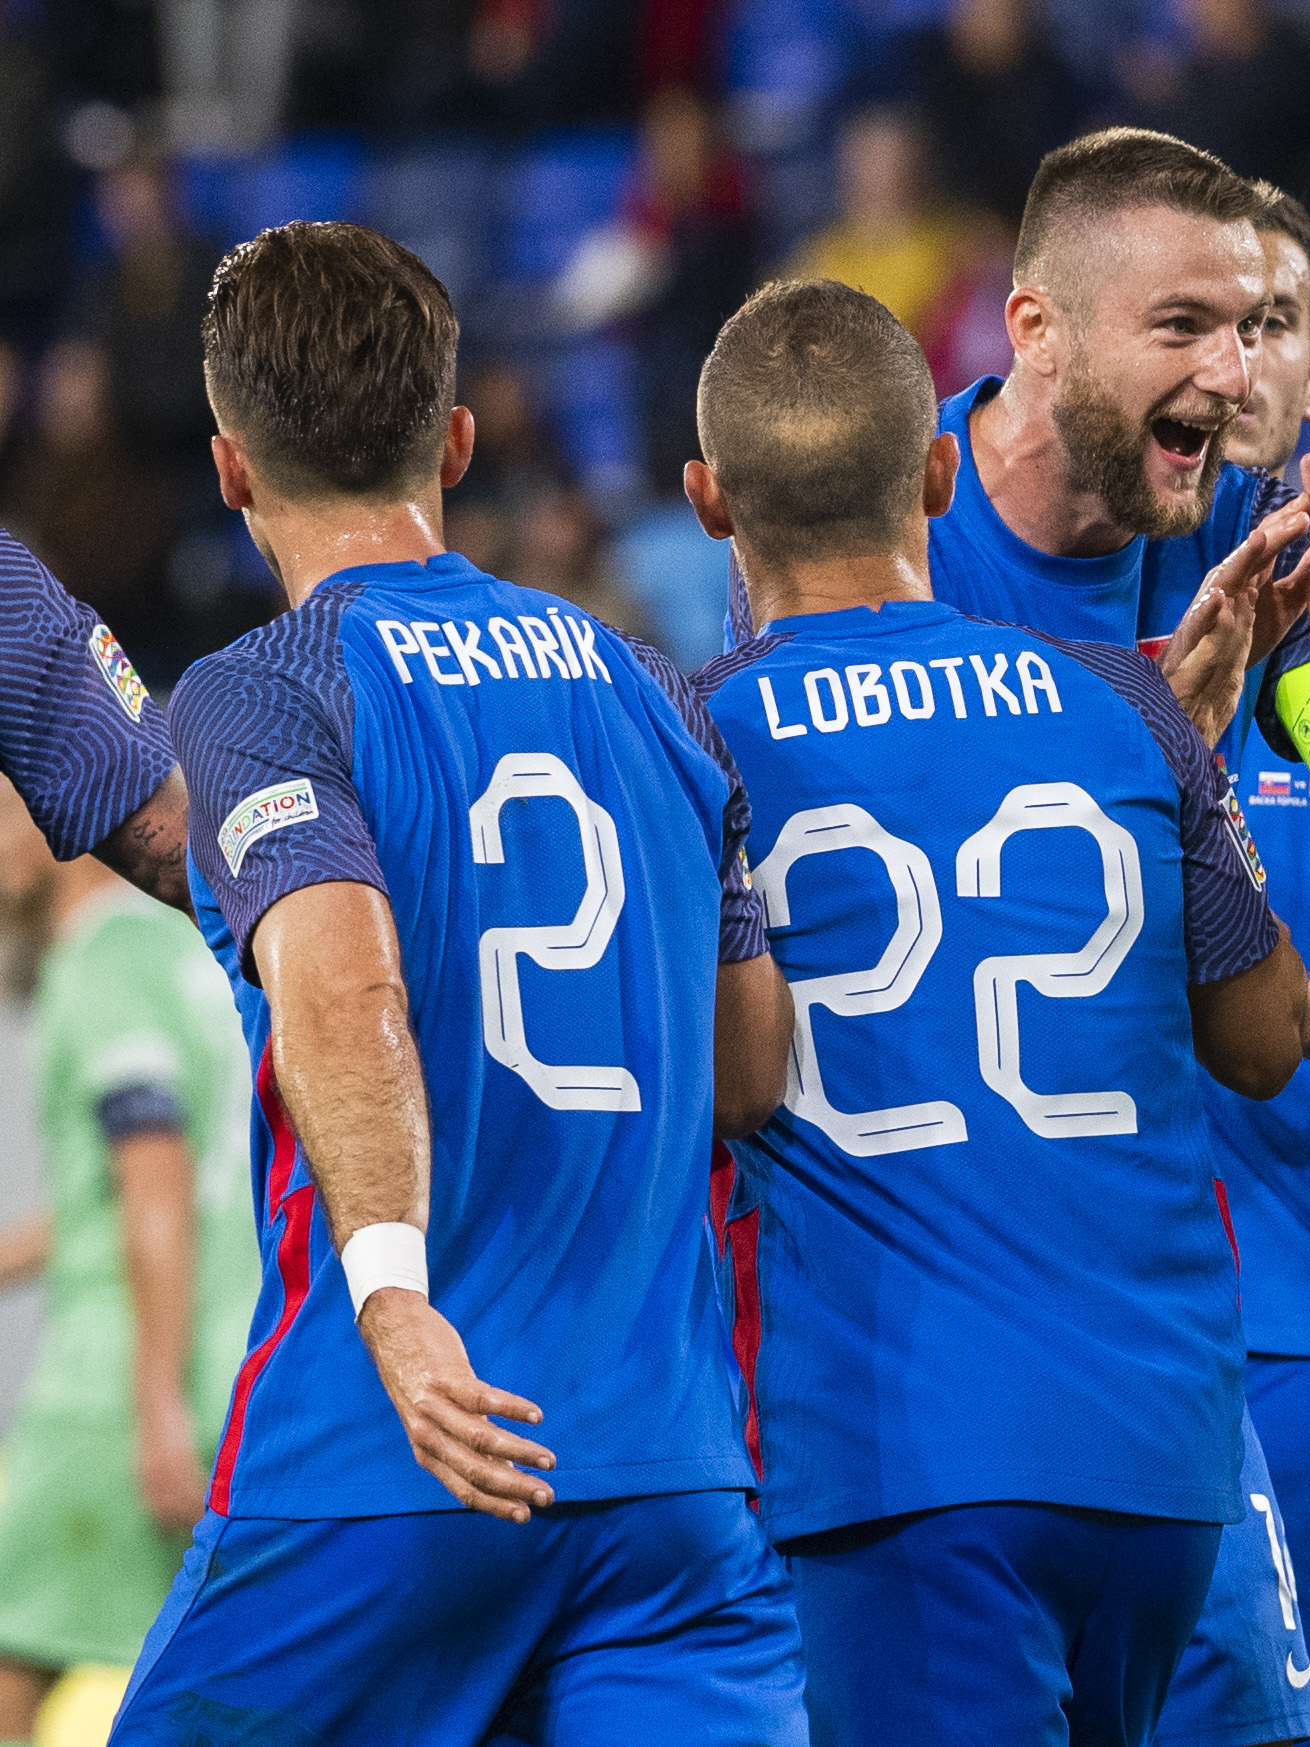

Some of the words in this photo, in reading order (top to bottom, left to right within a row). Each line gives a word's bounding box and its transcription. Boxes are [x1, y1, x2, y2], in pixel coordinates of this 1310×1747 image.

[375, 607, 613, 686] PEKARÍK
[757, 651, 1063, 741] LOBOTKA
[469, 752, 642, 1112] 2
[752, 781, 1144, 1158] 22
[1250, 1494, 1298, 1631] 1
